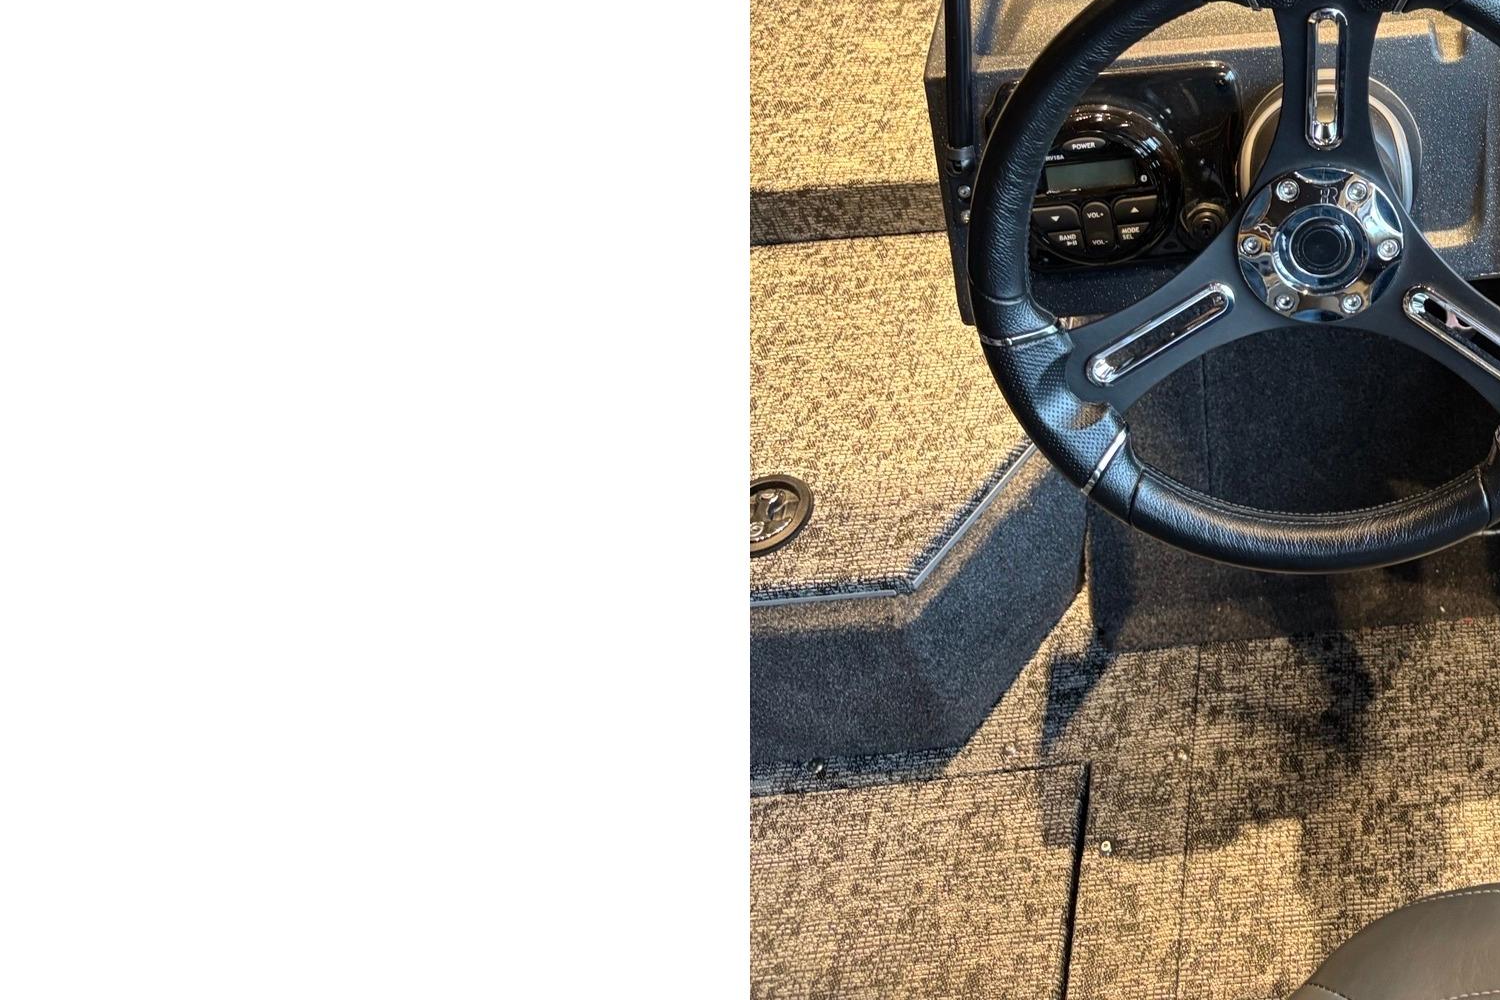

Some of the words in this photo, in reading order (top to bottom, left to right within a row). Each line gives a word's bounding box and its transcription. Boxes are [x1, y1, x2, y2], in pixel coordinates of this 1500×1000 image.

[1071, 142, 1096, 150] POWER
[1121, 226, 1140, 234] MODE
[1058, 233, 1077, 241] BAND
